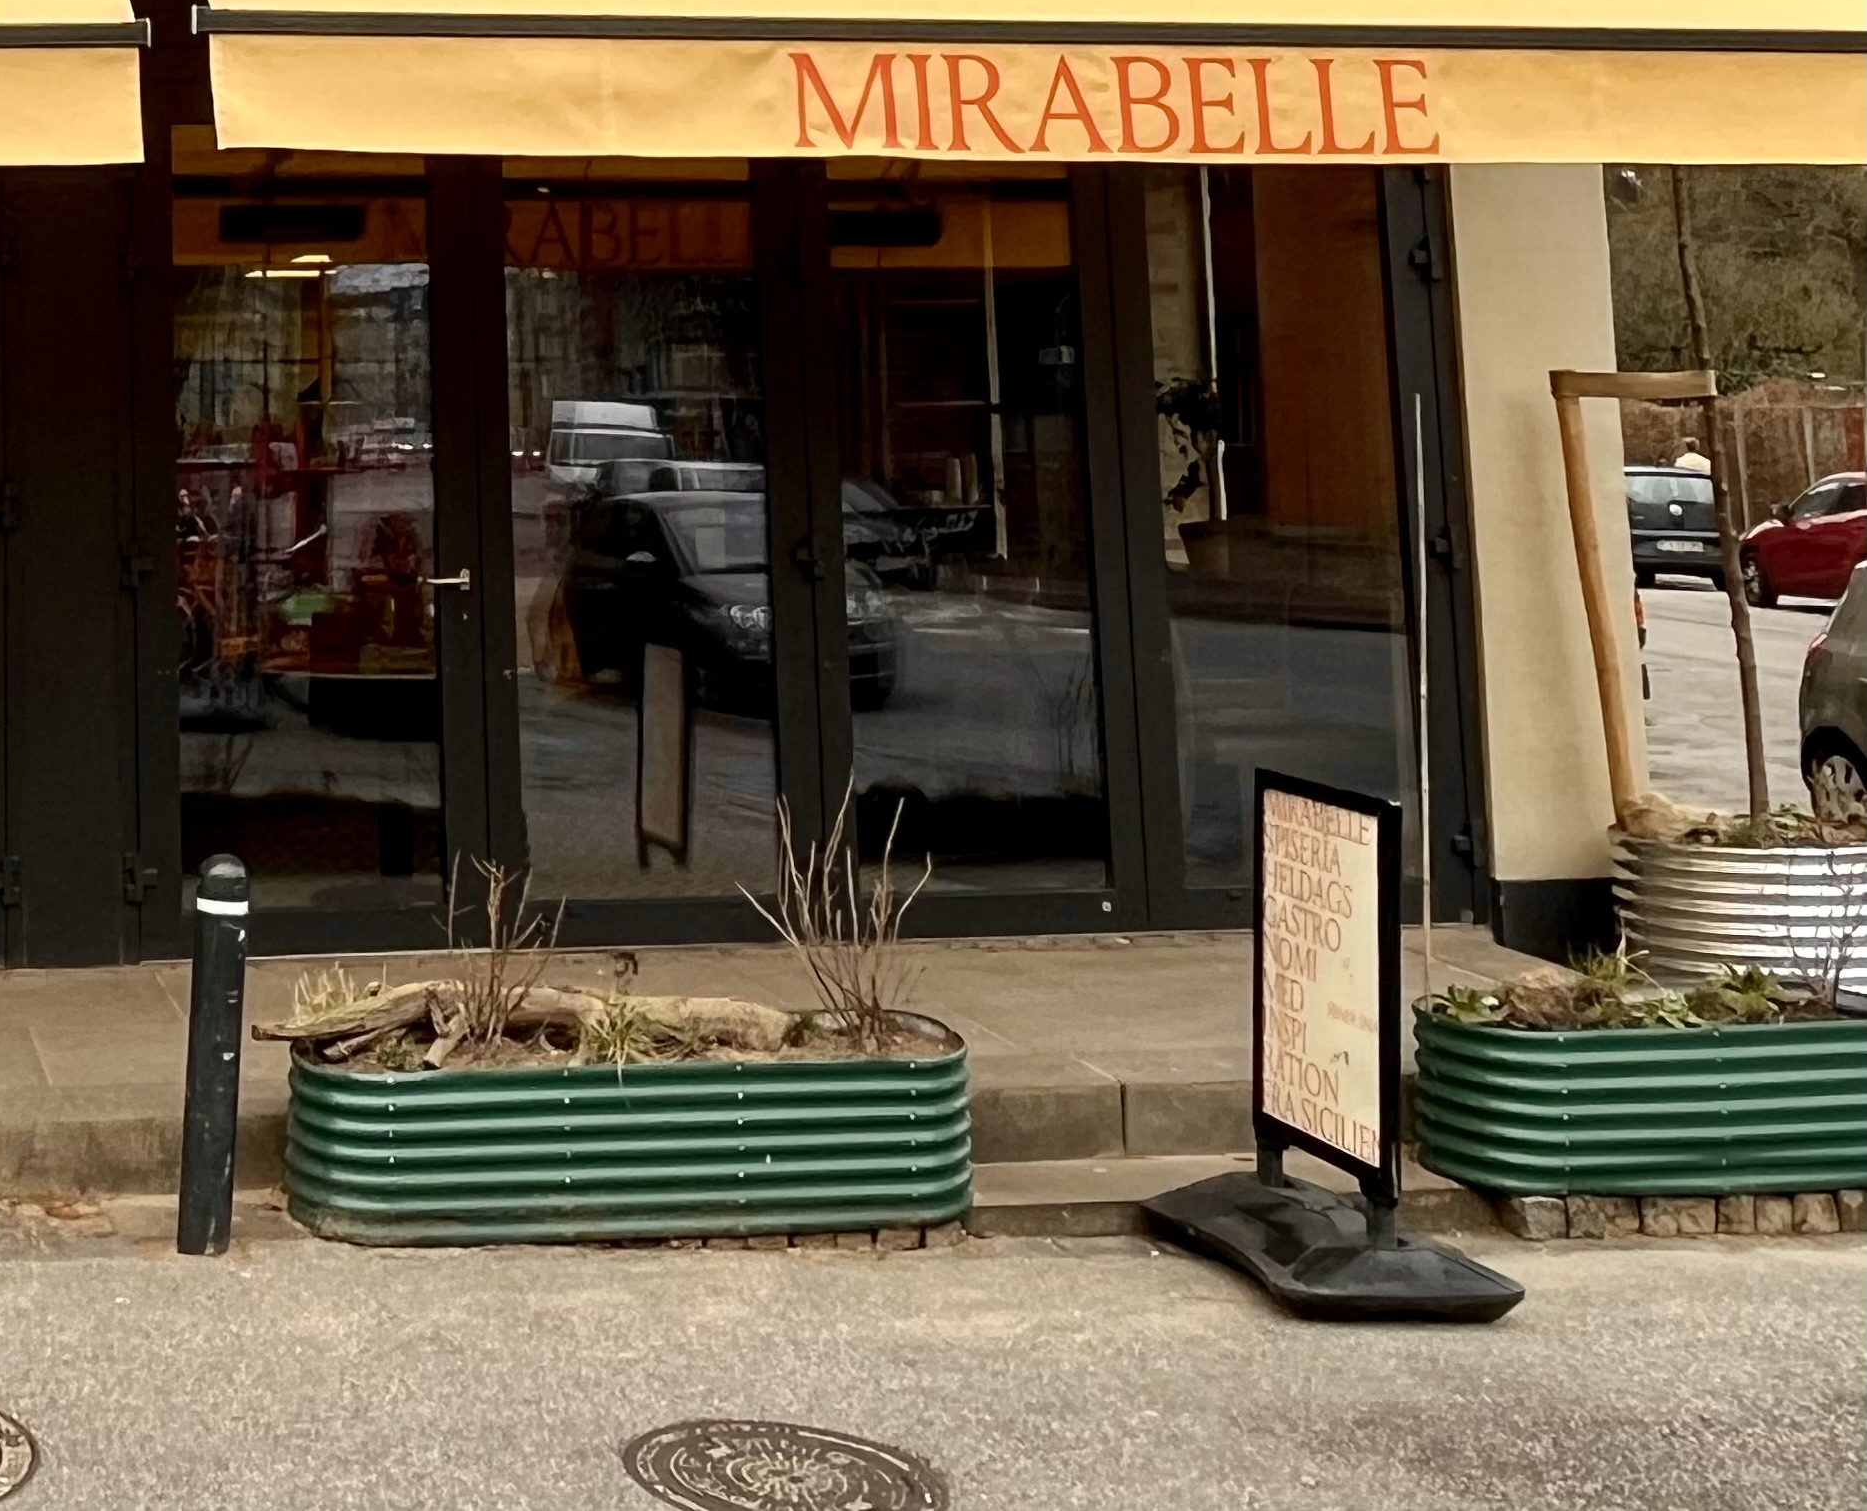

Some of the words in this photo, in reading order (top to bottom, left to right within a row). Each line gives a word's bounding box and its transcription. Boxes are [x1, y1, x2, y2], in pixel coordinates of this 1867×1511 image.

[787, 51, 1441, 156] MIRABELLE
[1268, 790, 1371, 846] MIRABELLE
[1264, 894, 1342, 952] GASTRO
